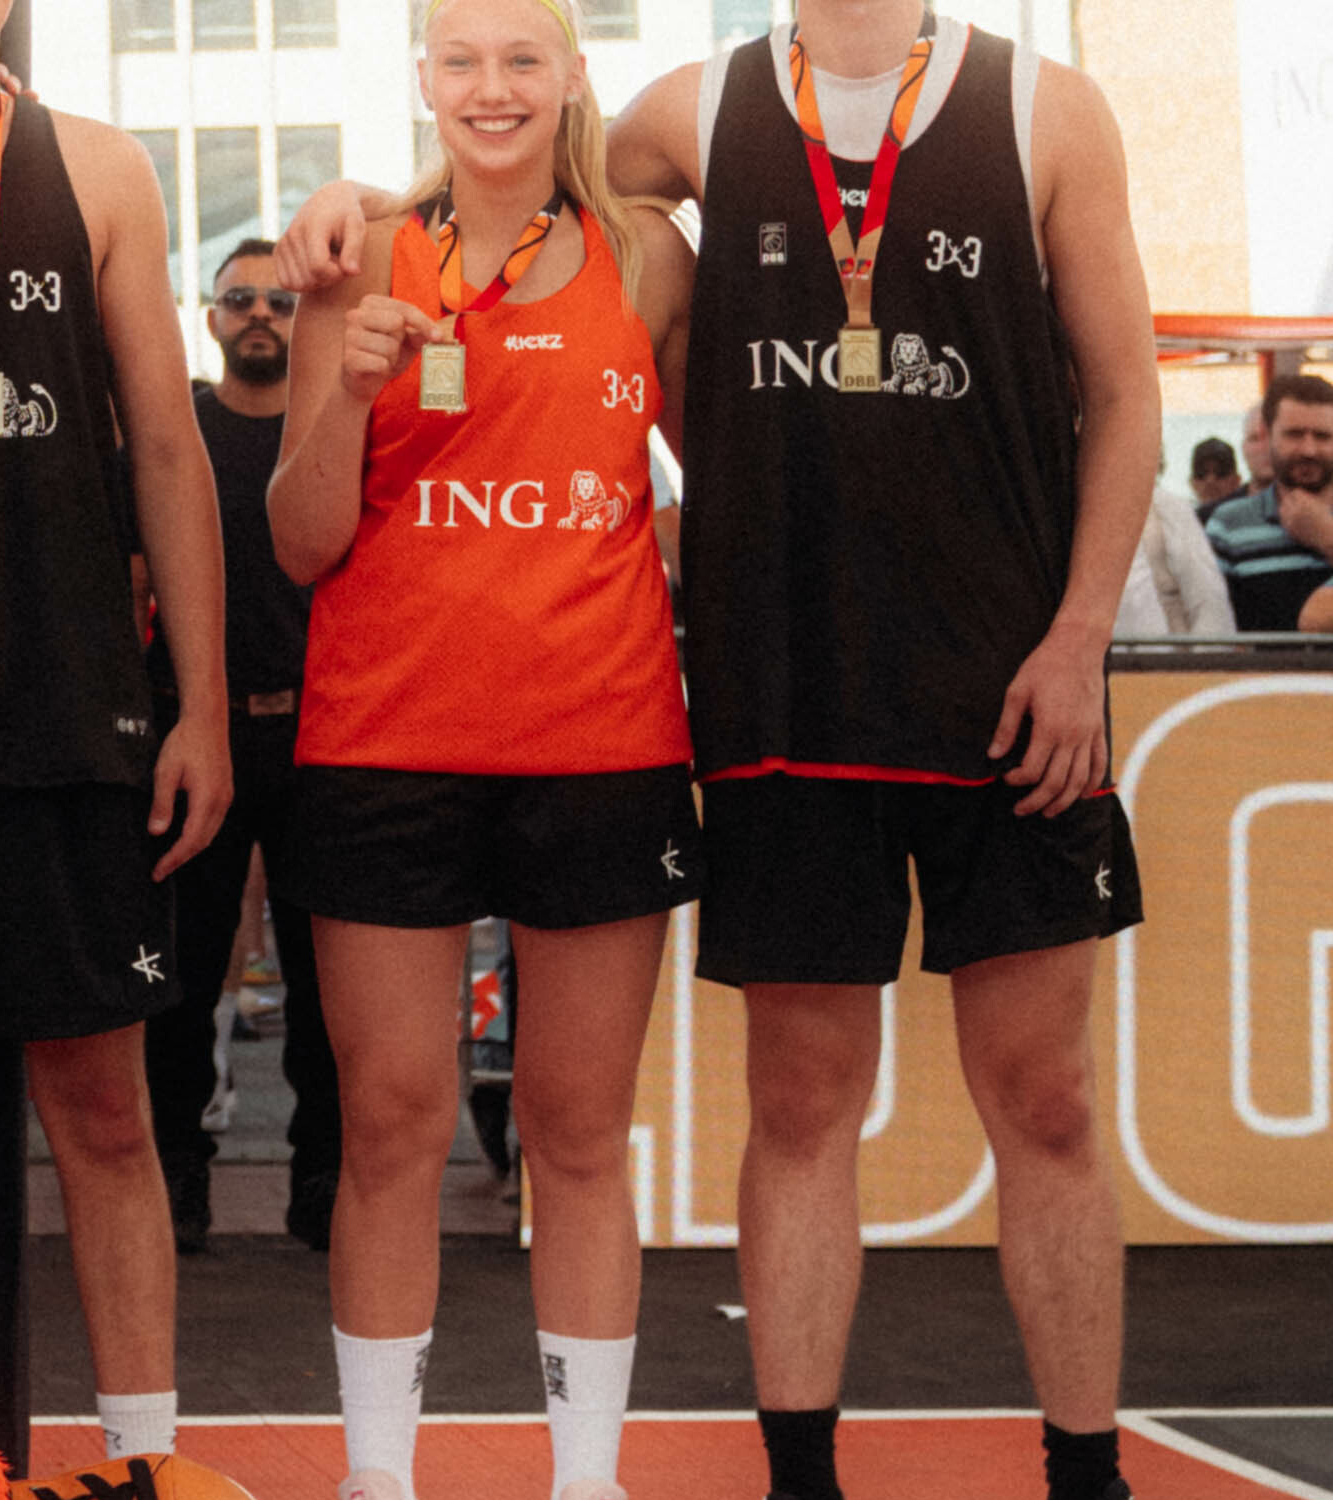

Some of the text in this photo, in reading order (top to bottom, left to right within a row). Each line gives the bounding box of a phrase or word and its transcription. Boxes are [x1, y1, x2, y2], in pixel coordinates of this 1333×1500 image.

[503, 334, 564, 352] KICKZ
[844, 375, 876, 388] DBB
[413, 479, 548, 529] ING
